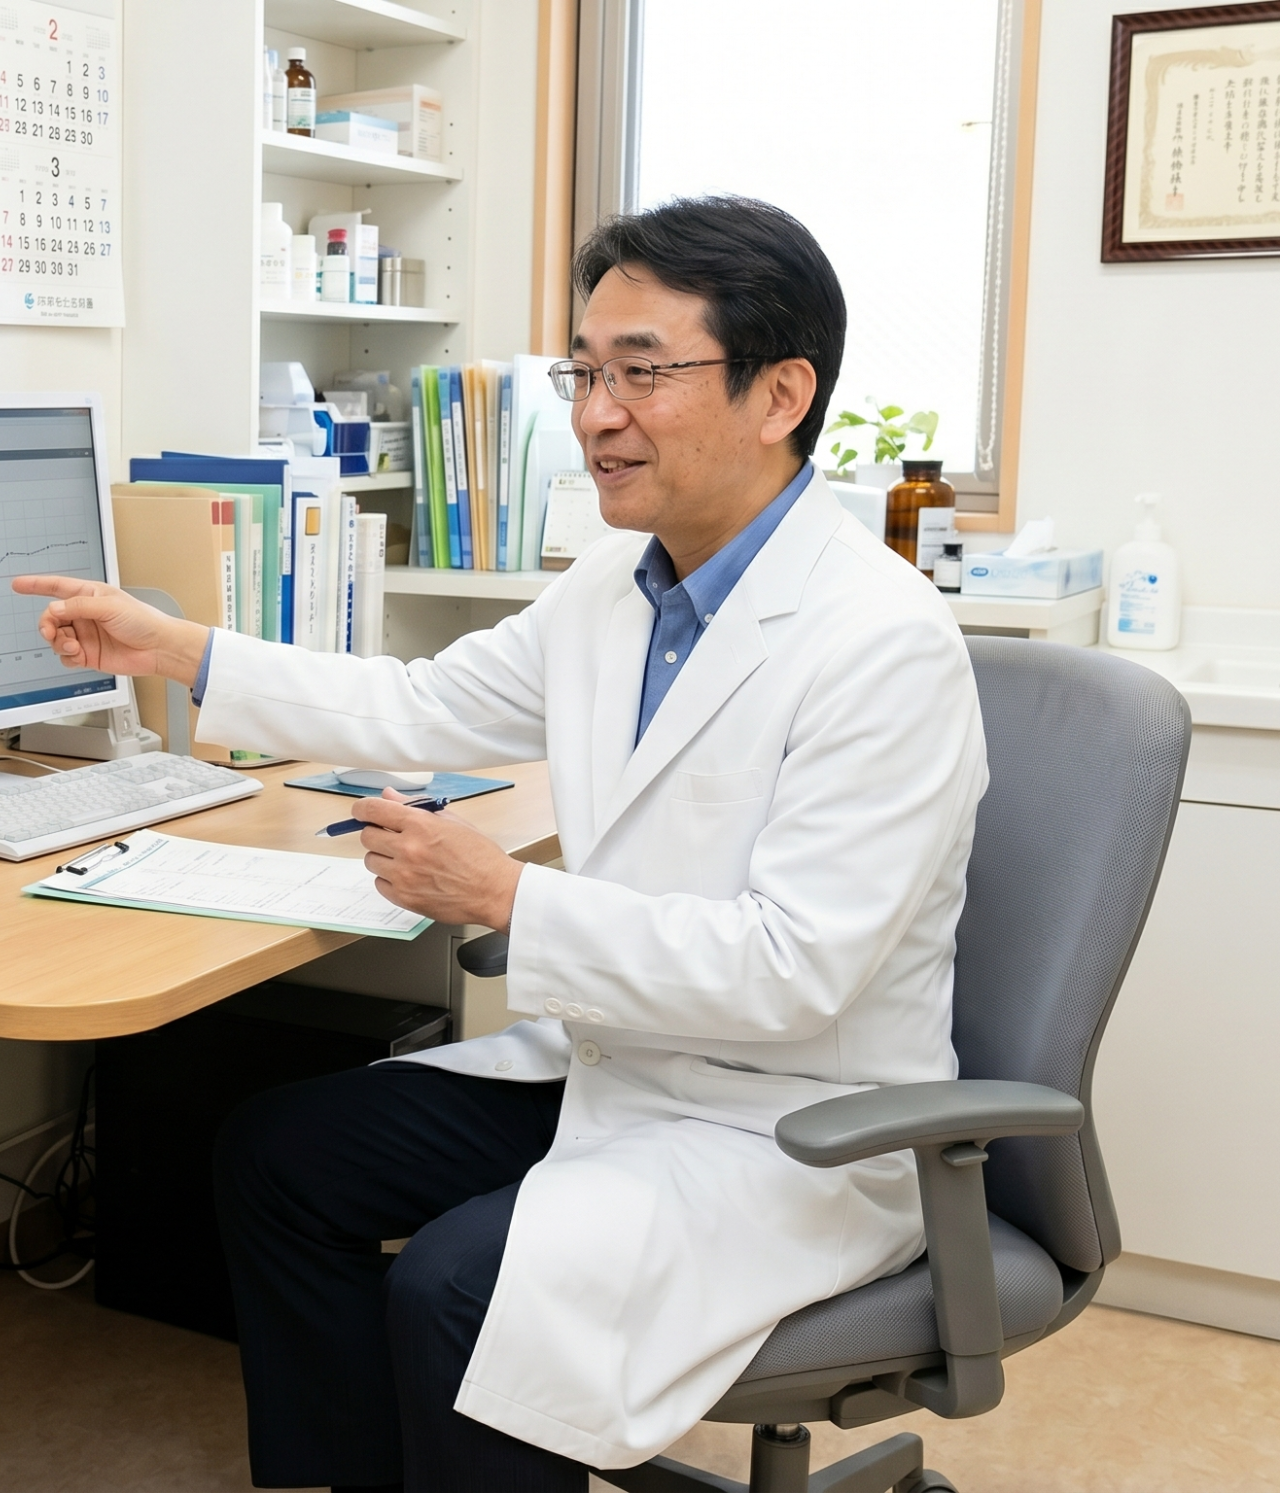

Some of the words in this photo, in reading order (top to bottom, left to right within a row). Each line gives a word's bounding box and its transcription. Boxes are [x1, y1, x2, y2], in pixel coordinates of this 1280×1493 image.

[49, 19, 58, 40] 2
[96, 89, 109, 103] 10
[15, 98, 27, 112] 12
[32, 101, 44, 115] 13
[48, 103, 60, 117] 14
[65, 106, 76, 120] 15
[81, 109, 92, 123] 16
[97, 112, 109, 126] 17
[32, 123, 43, 137] 21
[81, 131, 93, 145] 30
[51, 157, 60, 178] 3
[51, 216, 62, 230] 10
[67, 218, 78, 231] 11
[83, 219, 94, 233] 12
[100, 220, 110, 234] 13
[1, 234, 13, 248] 14
[19, 236, 30, 250] 15
[35, 238, 46, 251] 16
[51, 239, 62, 252] 24
[84, 242, 95, 256] 26
[100, 244, 111, 256] 27
[35, 260, 46, 274] 30
[68, 262, 78, 276] 31
